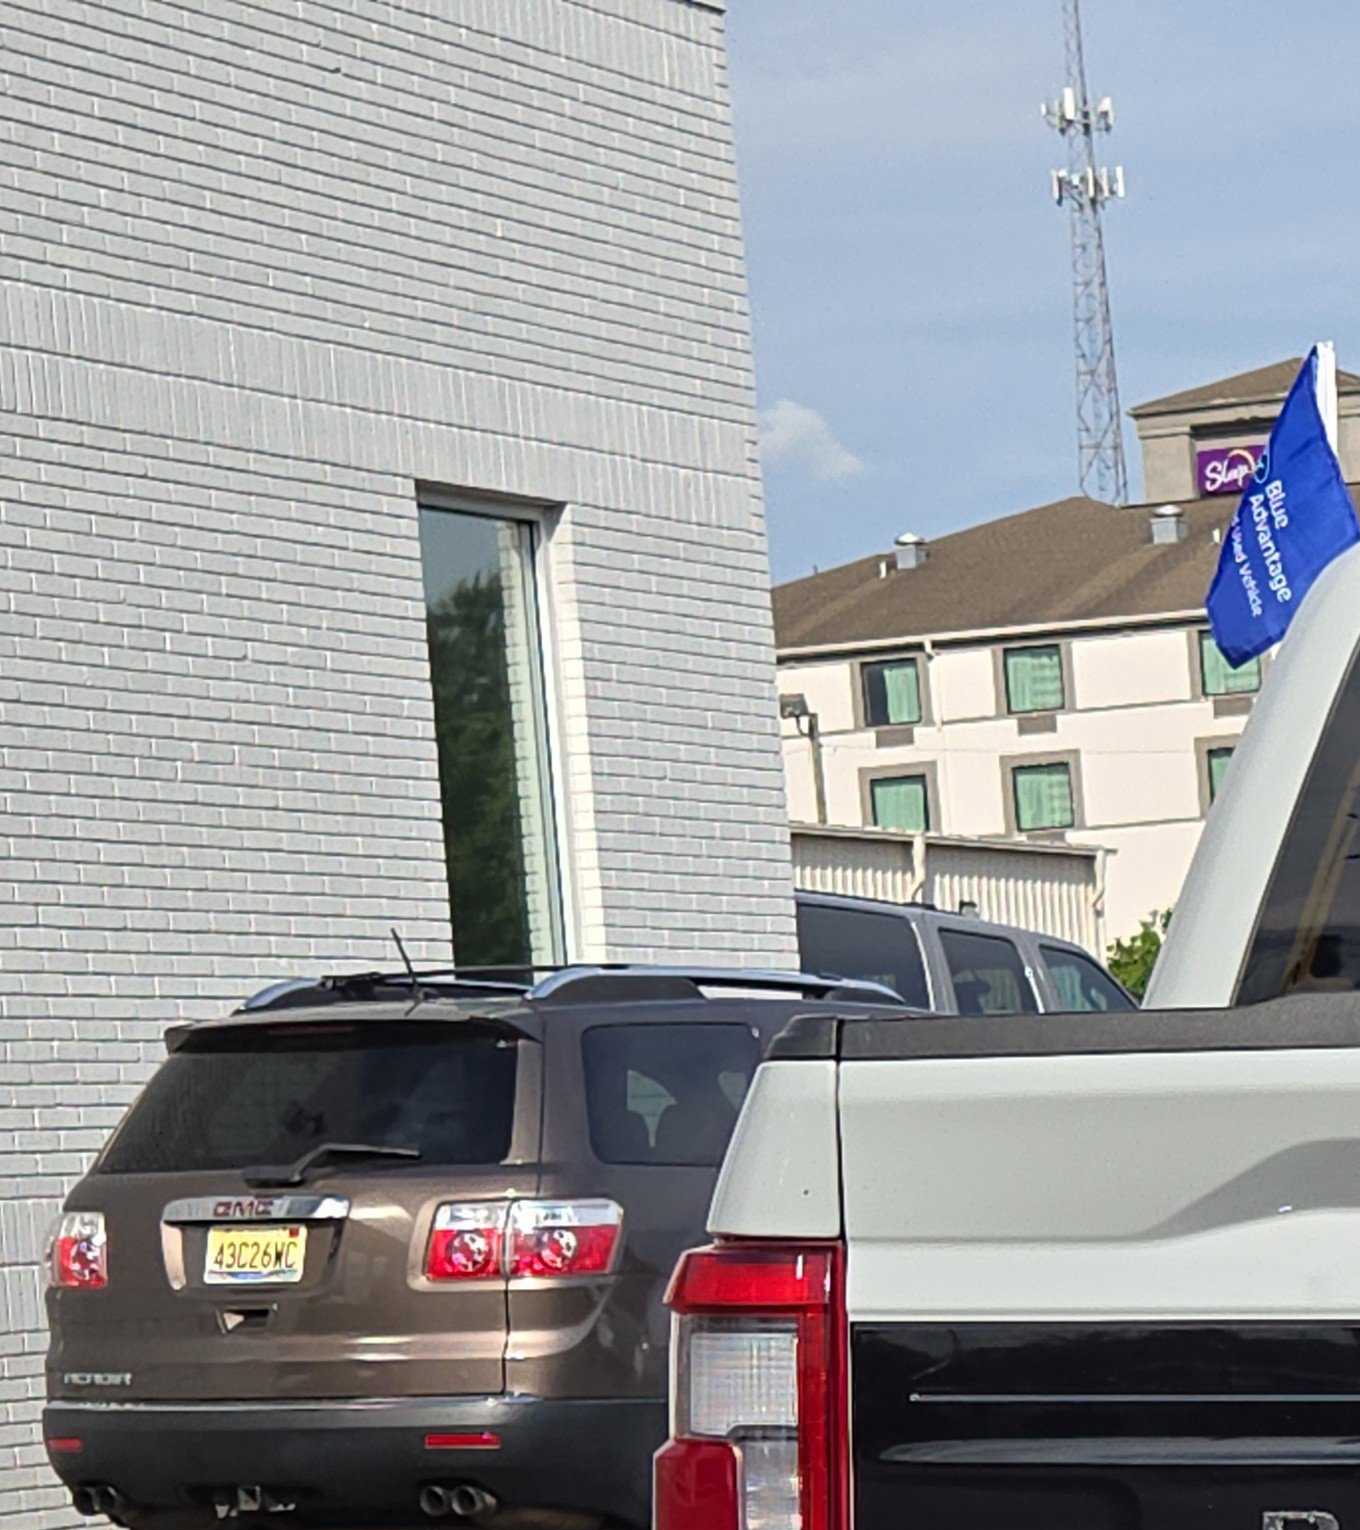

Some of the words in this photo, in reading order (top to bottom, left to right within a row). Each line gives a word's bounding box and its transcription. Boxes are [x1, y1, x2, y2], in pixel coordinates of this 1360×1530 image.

[1265, 480, 1289, 530] Blue
[1250, 494, 1292, 603] Advantage
[213, 1200, 274, 1217] GMC
